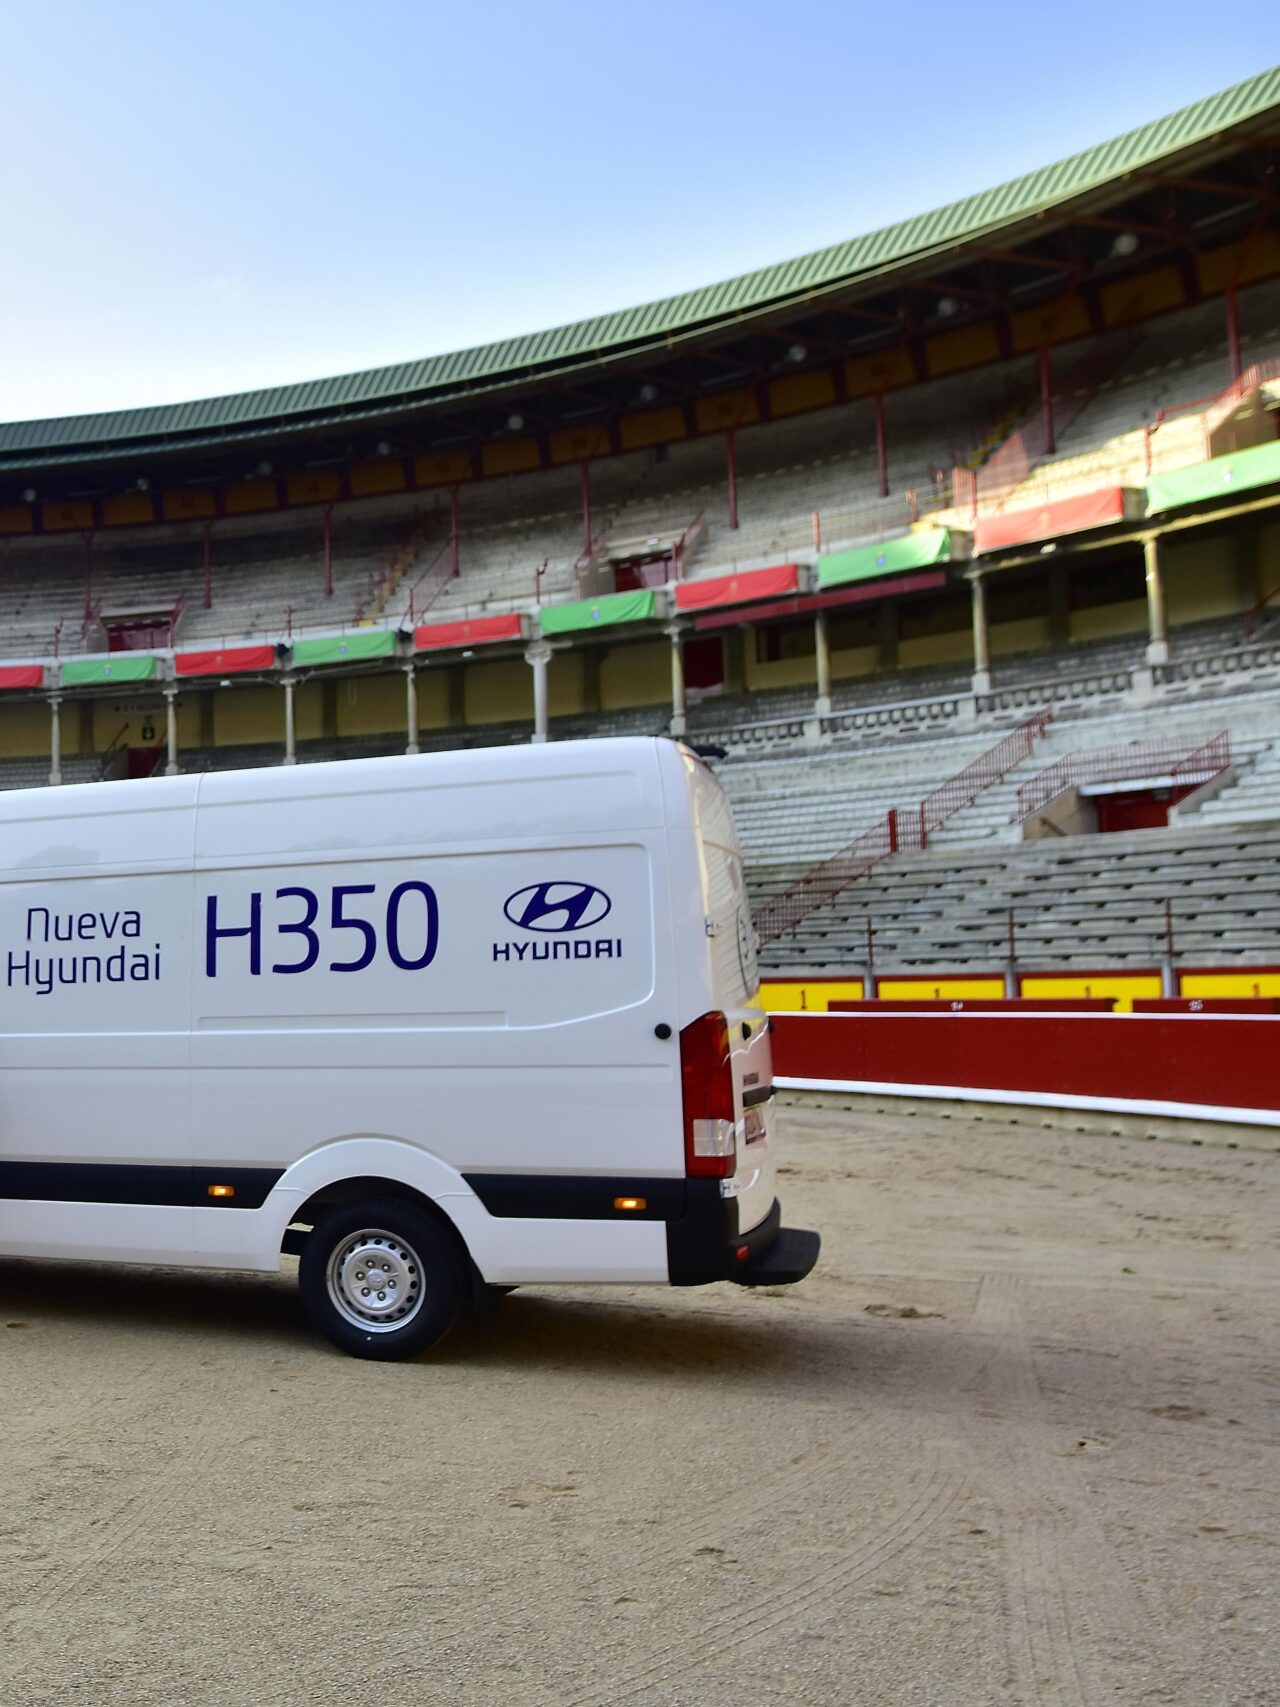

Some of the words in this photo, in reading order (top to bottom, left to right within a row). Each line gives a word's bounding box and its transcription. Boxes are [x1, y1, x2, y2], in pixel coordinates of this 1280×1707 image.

[26, 907, 141, 942] Nueva
[206, 881, 439, 977] H350
[7, 944, 160, 995] Hyundai
[493, 938, 622, 962] HYUNDAI
